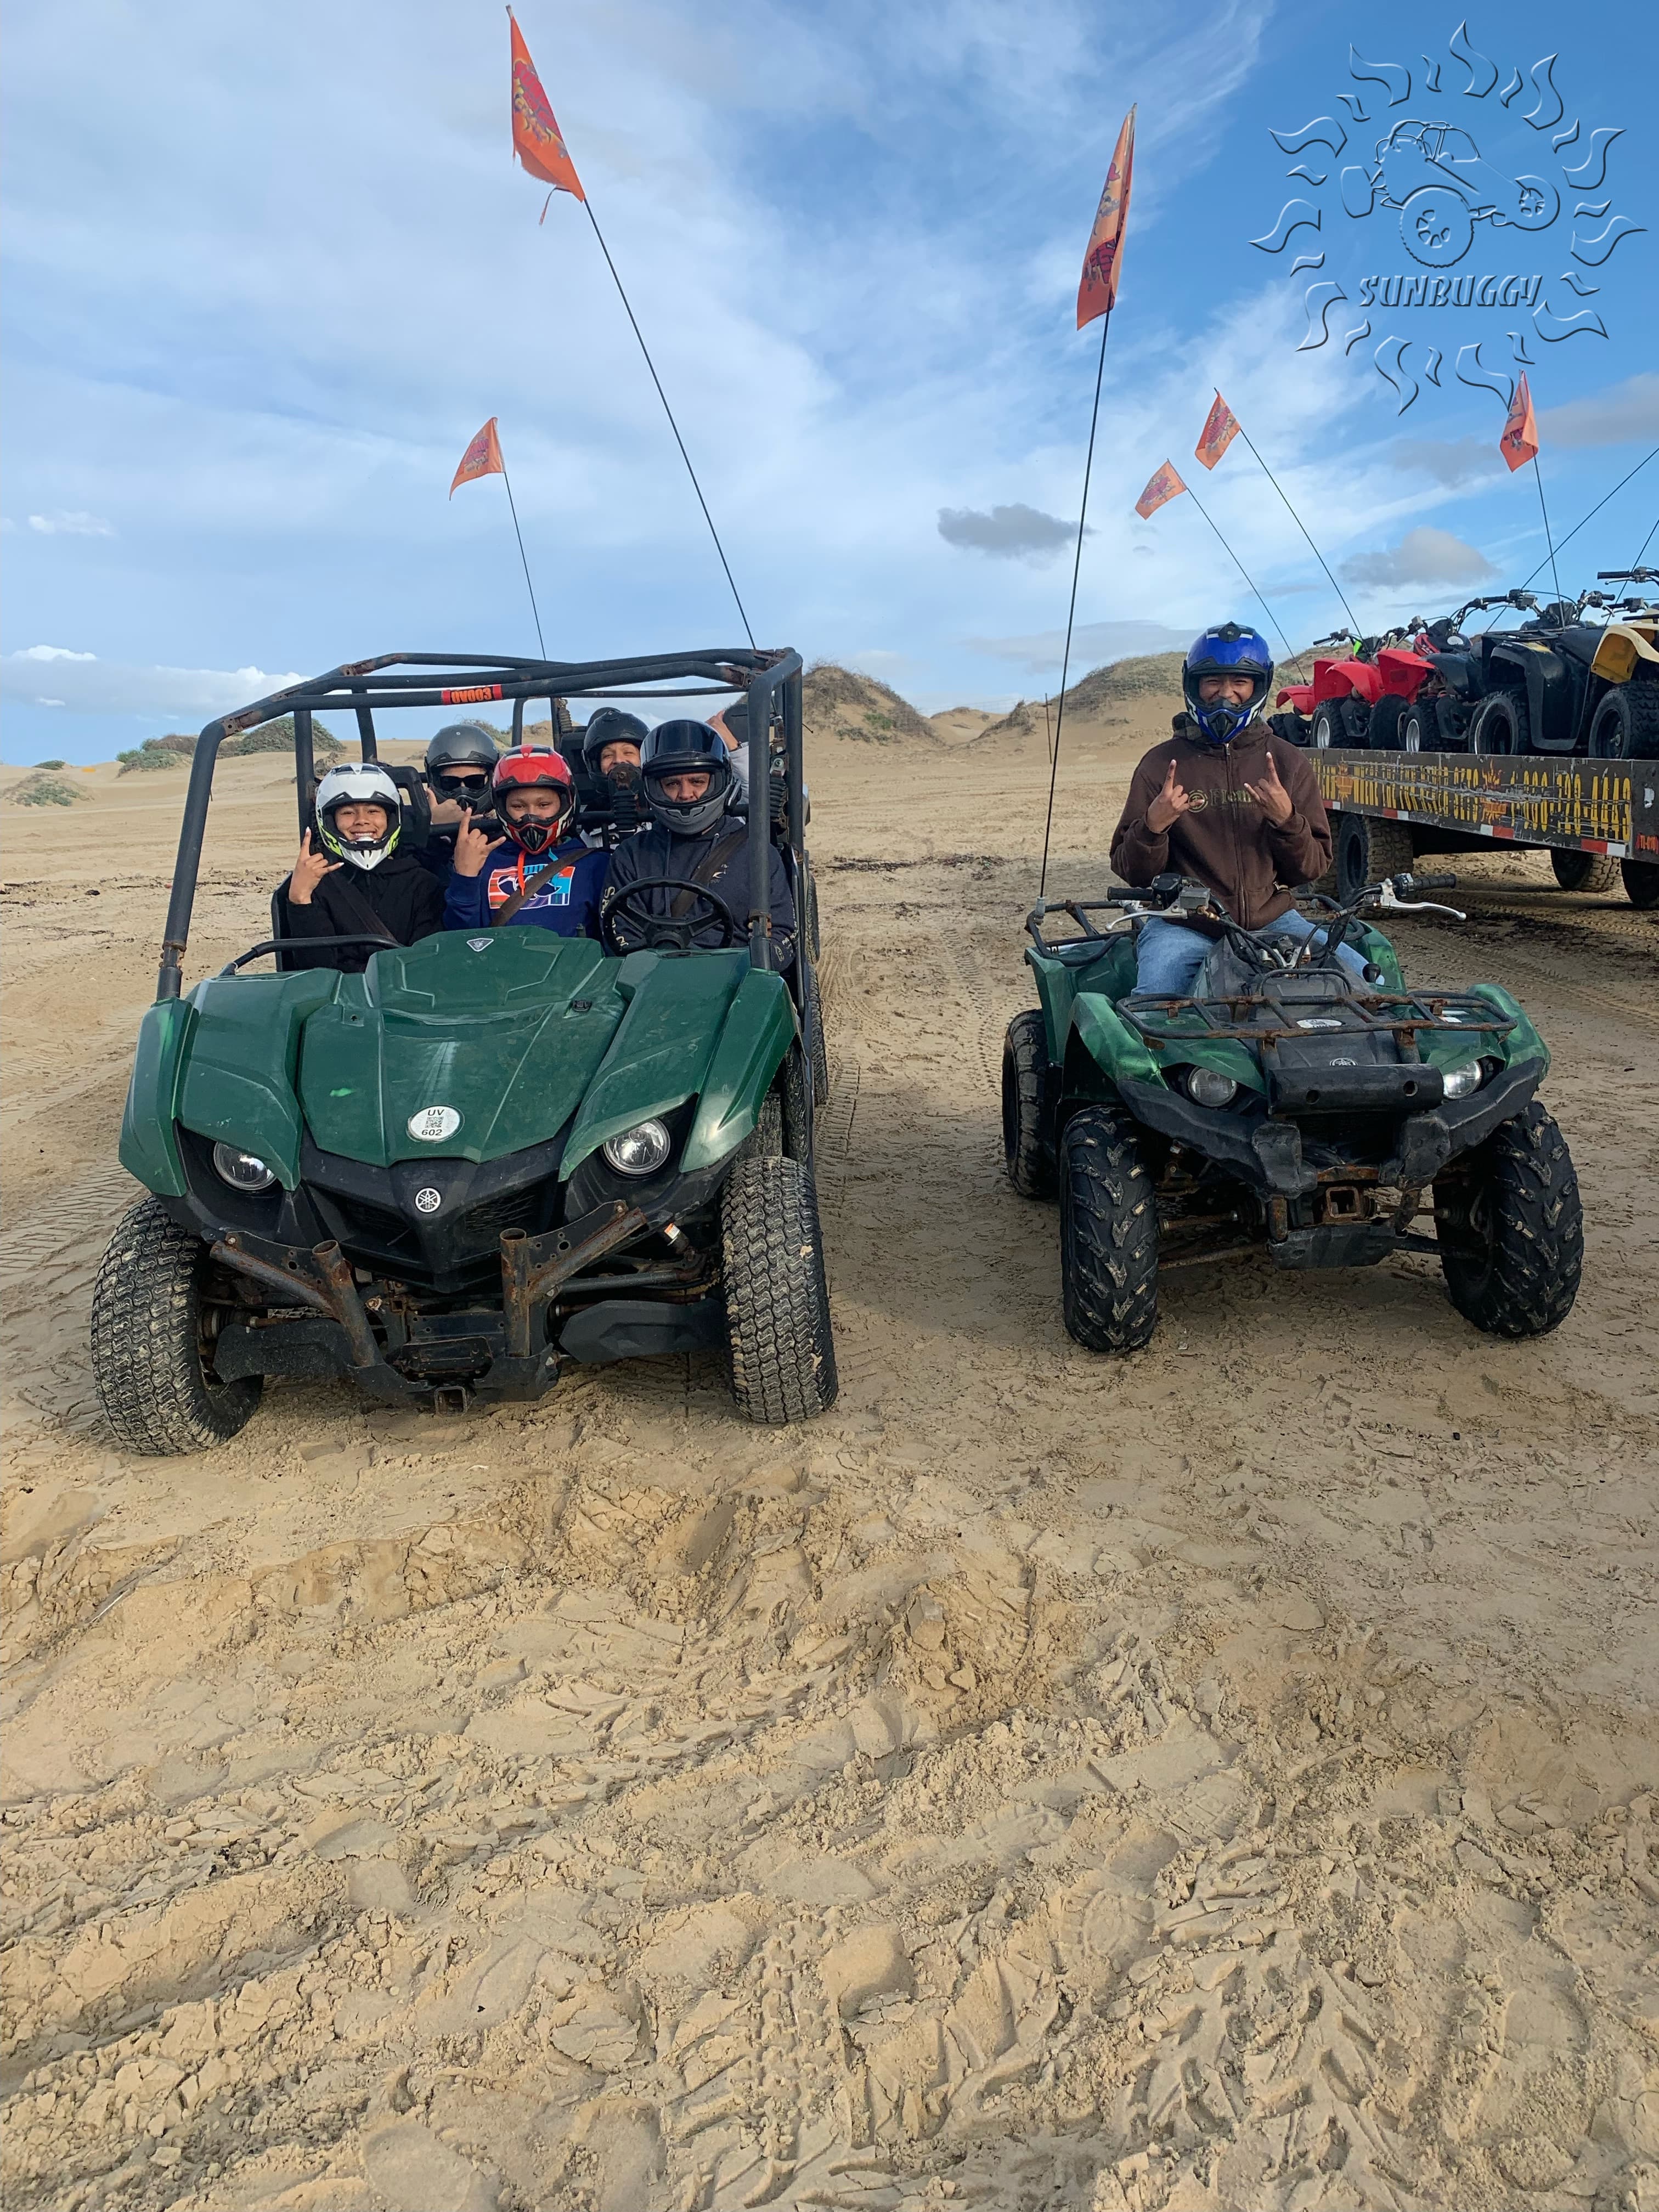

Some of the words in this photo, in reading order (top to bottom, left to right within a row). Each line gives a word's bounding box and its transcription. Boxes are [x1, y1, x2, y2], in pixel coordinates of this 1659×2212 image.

[1353, 761, 1379, 806] WHERE
[1381, 762, 1397, 809] THE
[1400, 763, 1419, 811] FUN
[1453, 766, 1479, 823] SETS
